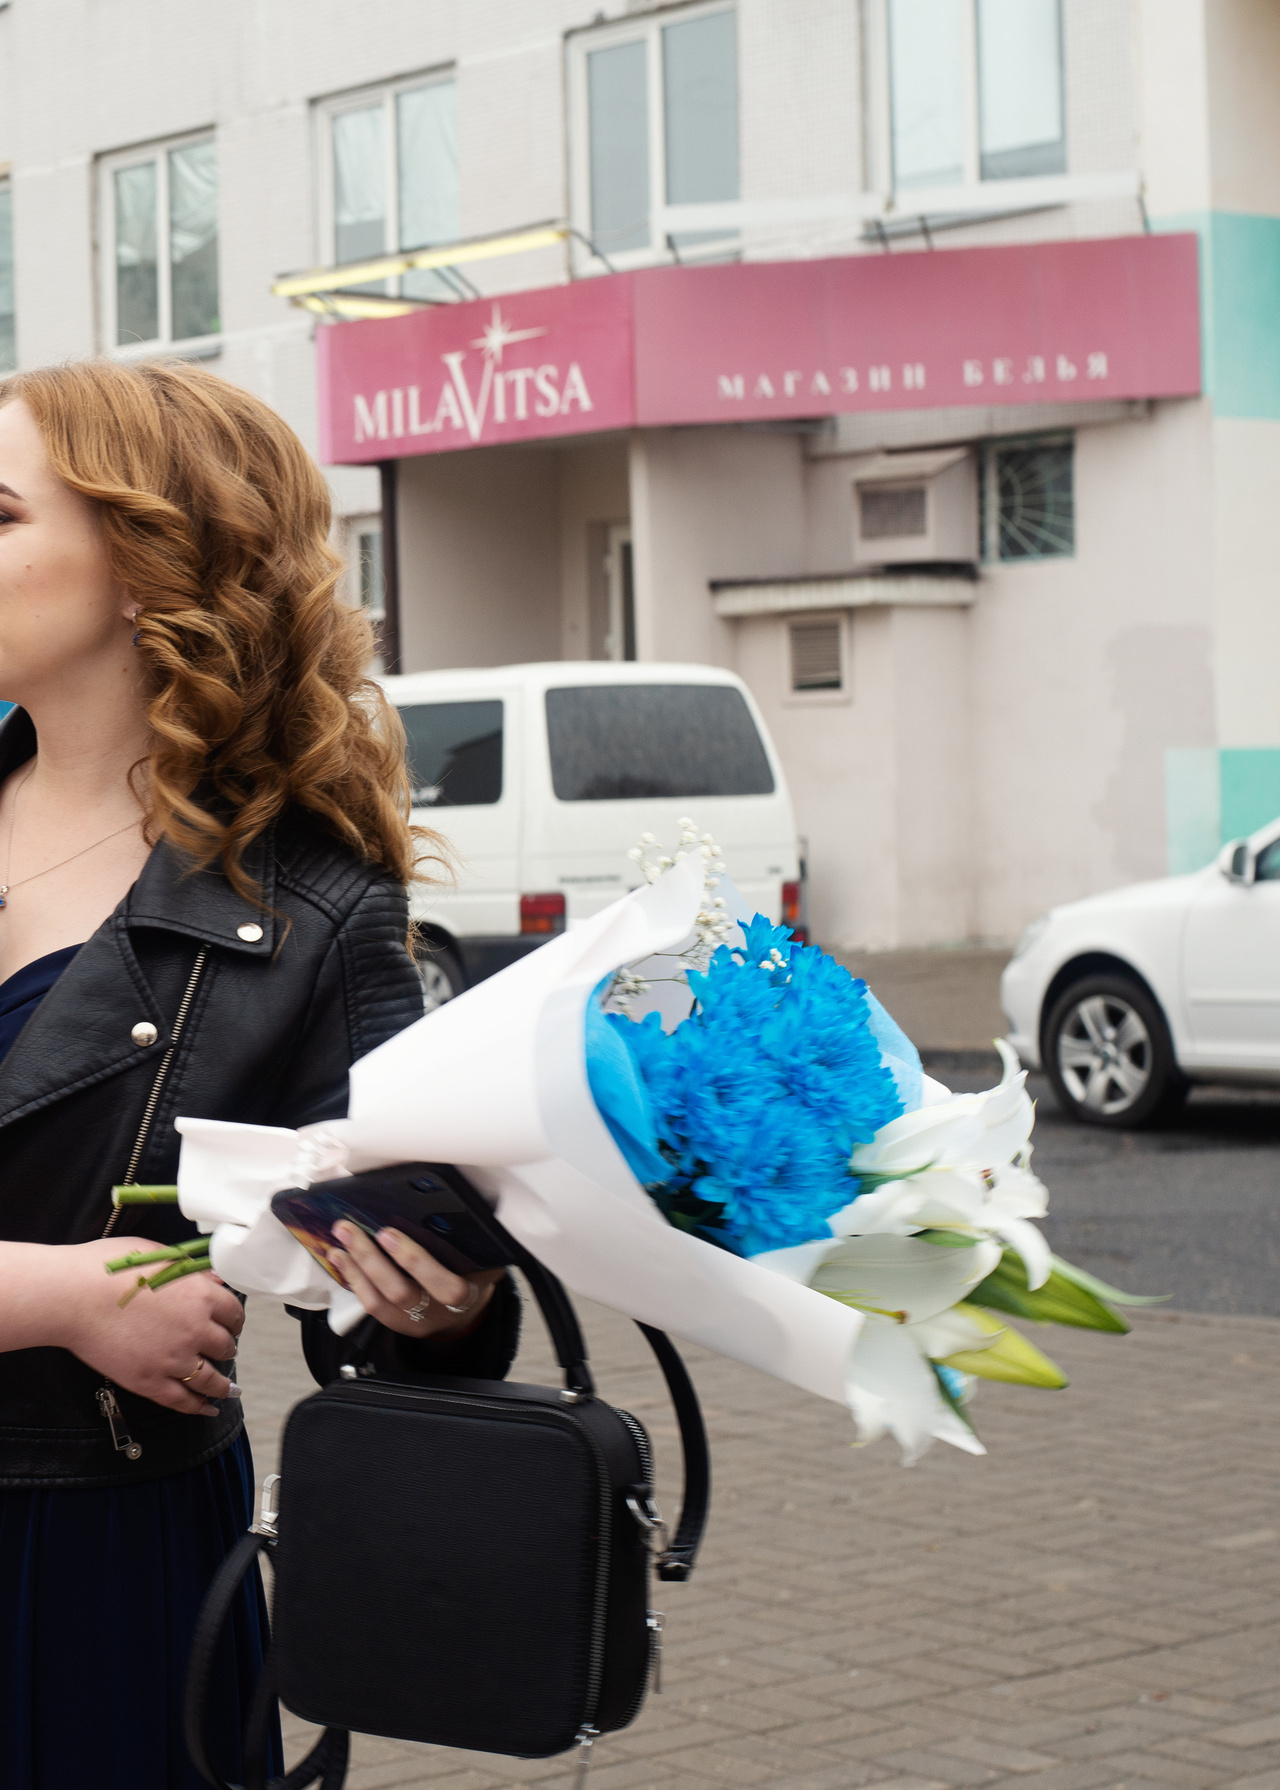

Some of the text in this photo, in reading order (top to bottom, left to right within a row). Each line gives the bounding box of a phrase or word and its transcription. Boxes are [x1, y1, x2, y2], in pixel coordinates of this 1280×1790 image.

[353, 351, 594, 443] MILAVITSA
[717, 351, 1109, 401] МАГАЗИН БЕЛЬЯ
